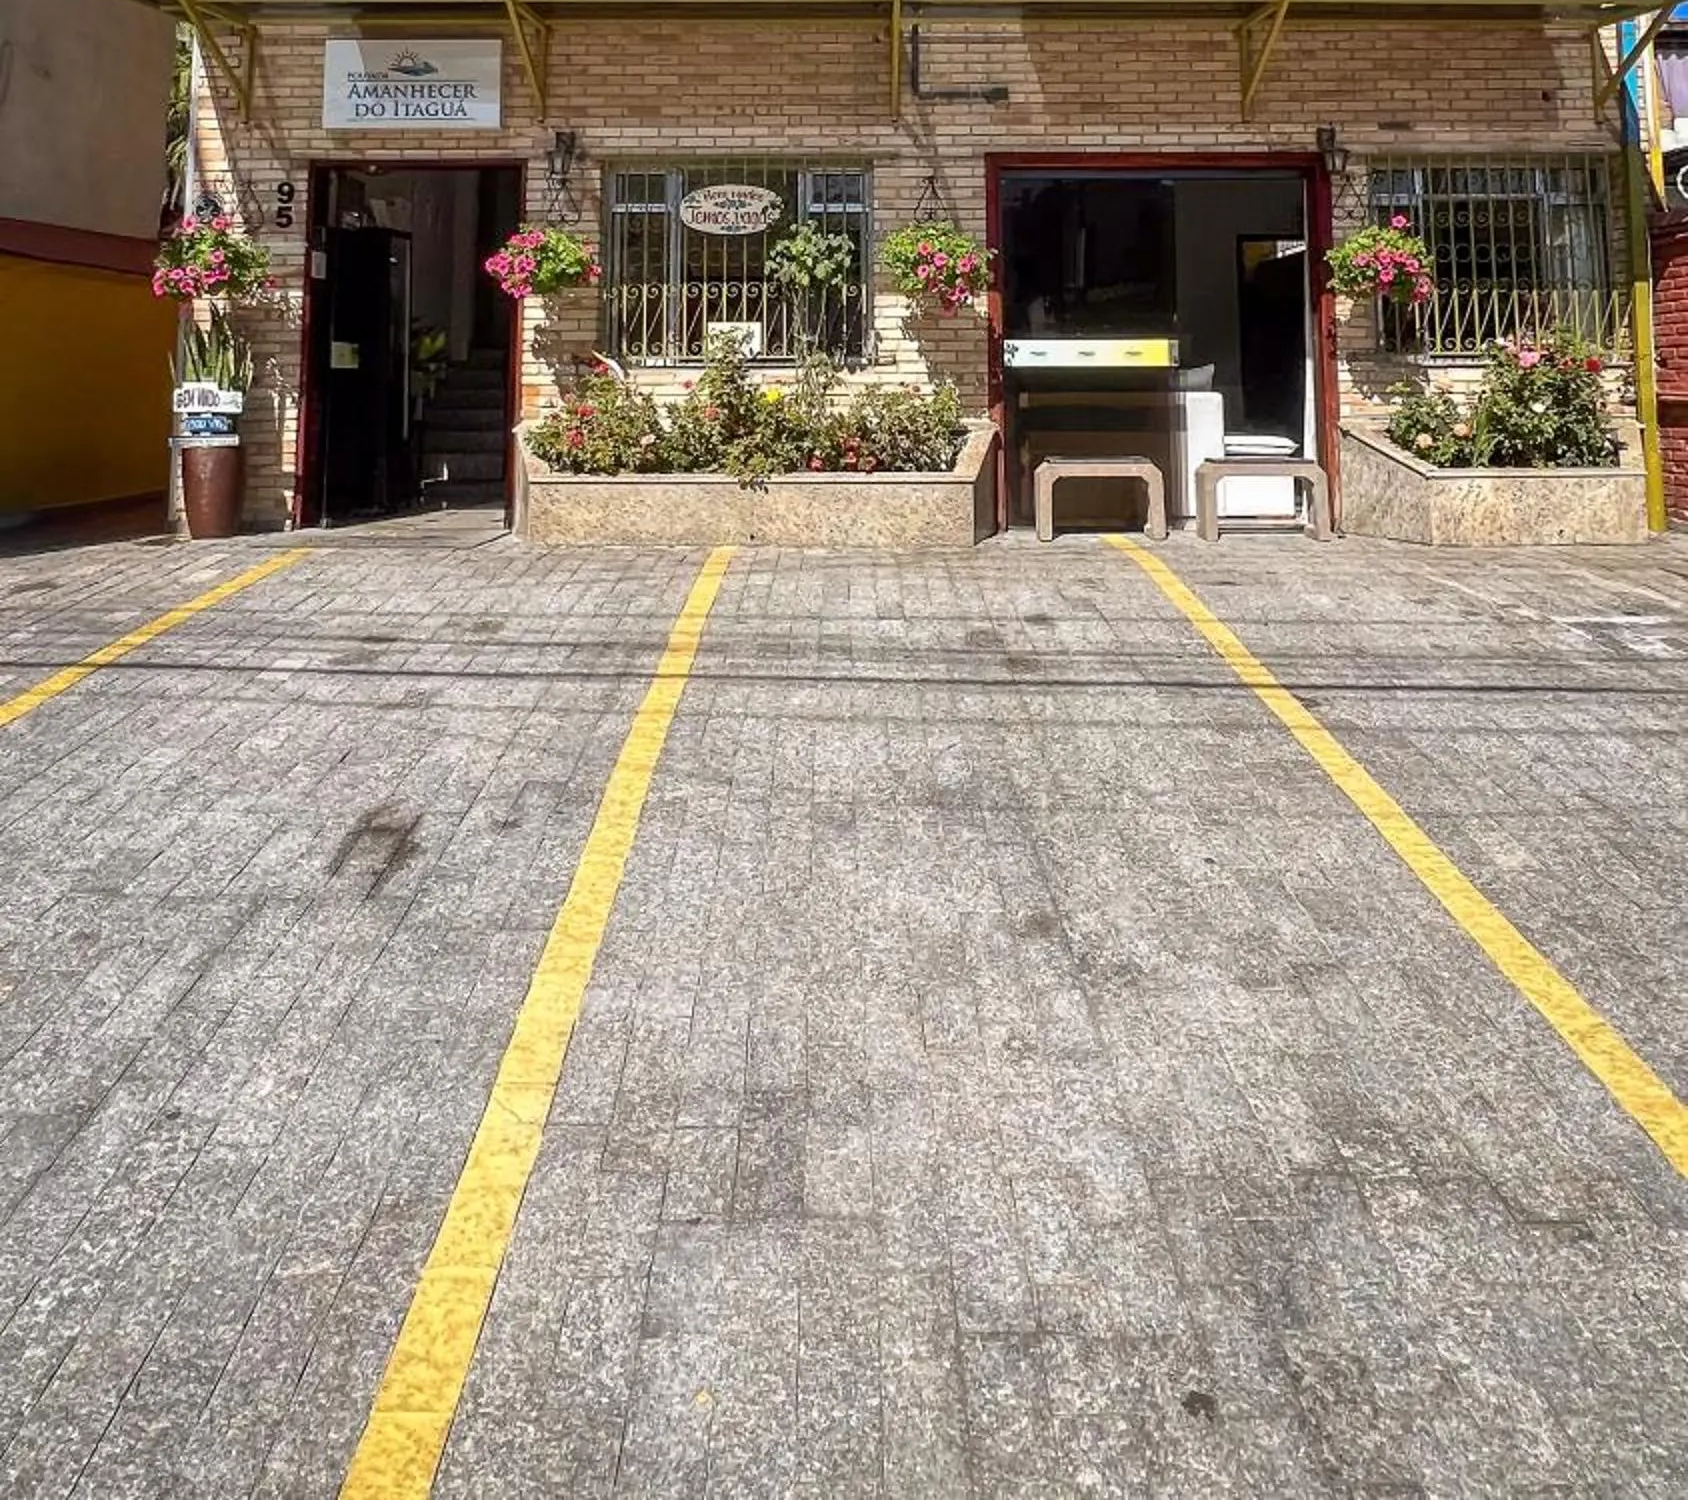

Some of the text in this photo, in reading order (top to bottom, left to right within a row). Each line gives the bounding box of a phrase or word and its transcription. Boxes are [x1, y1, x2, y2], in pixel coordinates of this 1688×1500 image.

[347, 83, 479, 100] AMANHECER
[355, 99, 469, 117] DO ITAGUÁ
